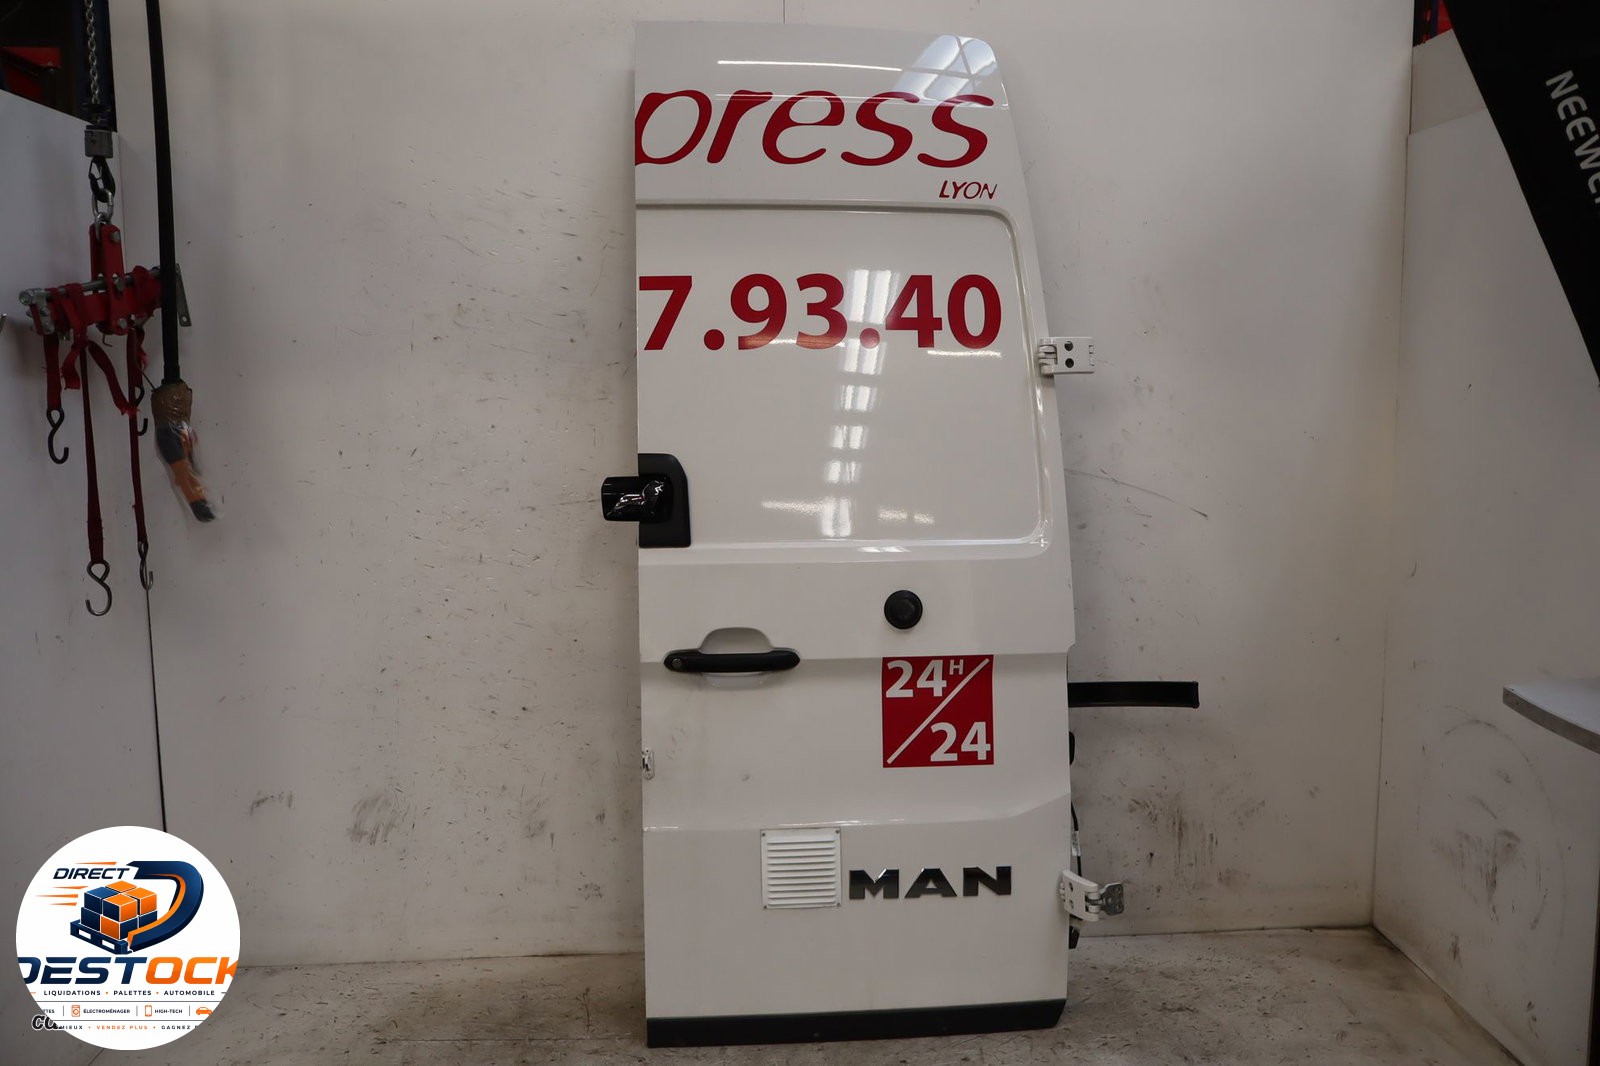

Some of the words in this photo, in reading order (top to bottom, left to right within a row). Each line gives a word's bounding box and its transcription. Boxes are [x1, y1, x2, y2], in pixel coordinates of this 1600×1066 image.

[939, 180, 998, 199] LYON
[638, 273, 1002, 351] 7.93.40
[930, 721, 991, 762] 24
[849, 865, 1012, 900] MAN
